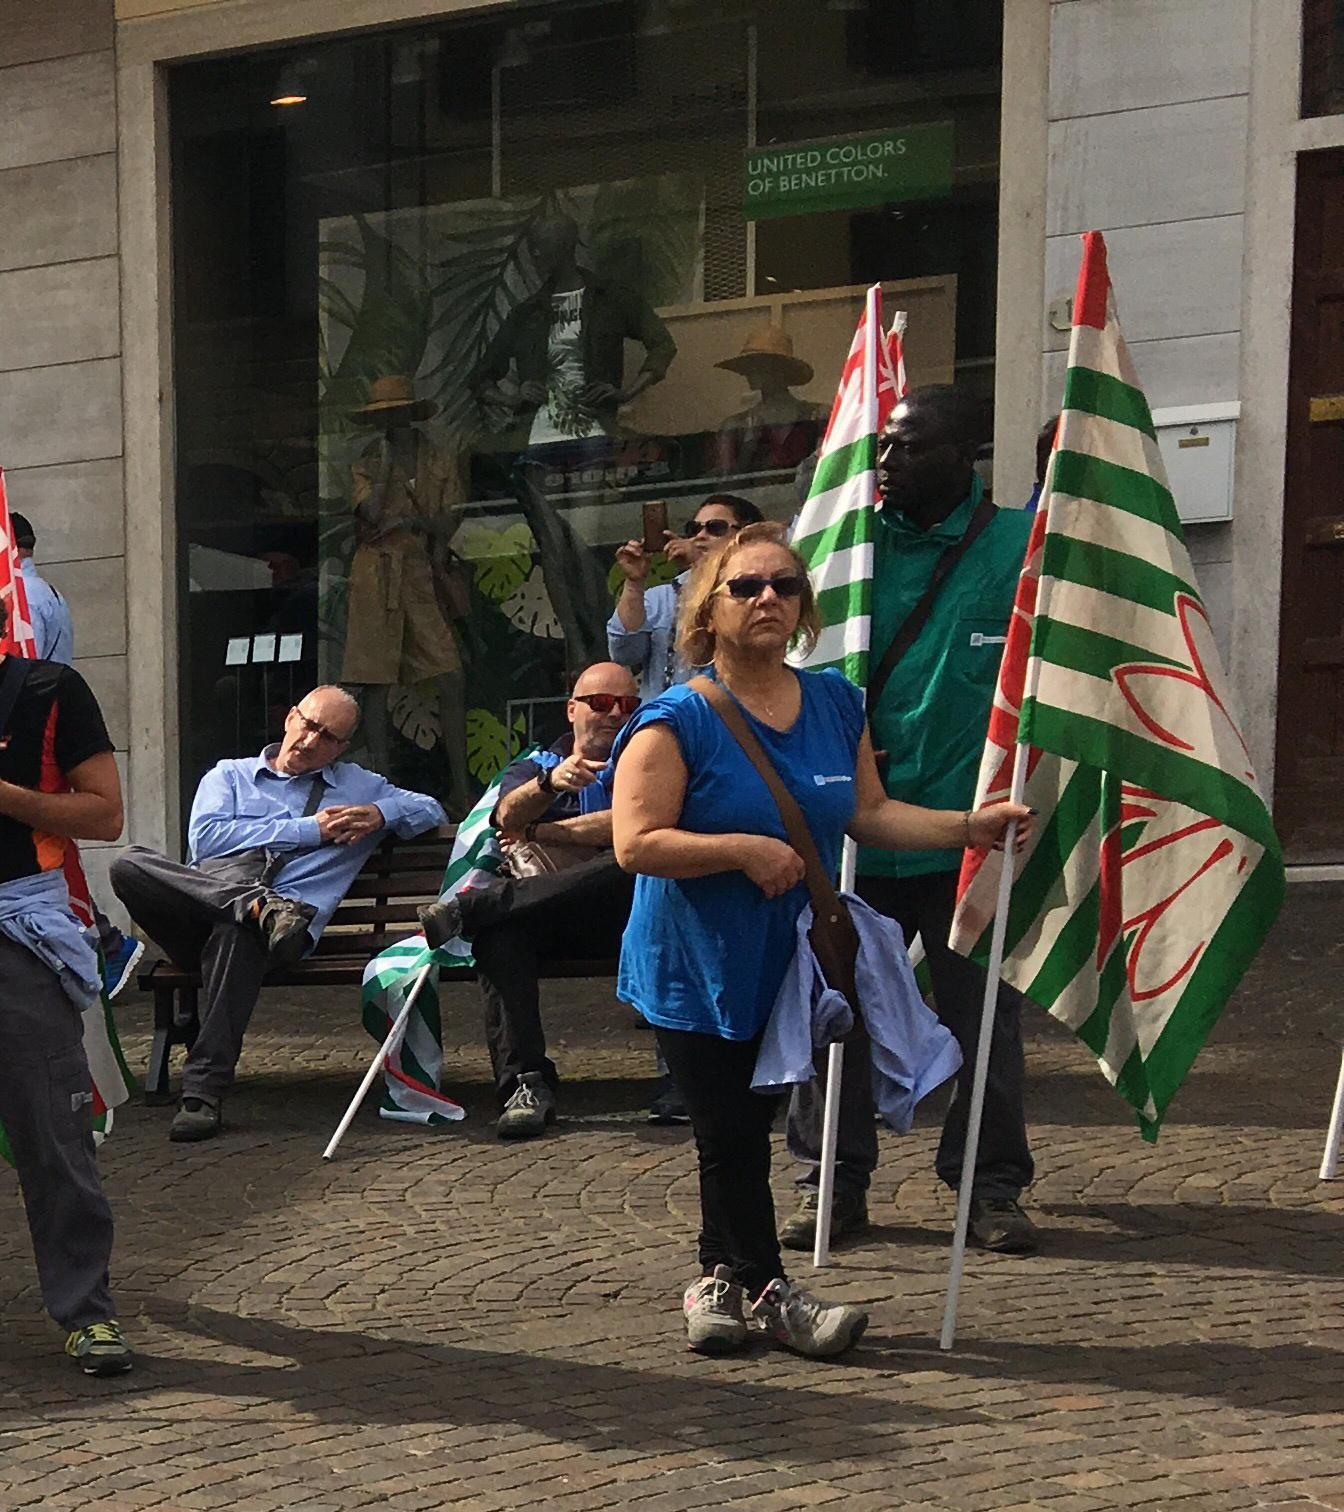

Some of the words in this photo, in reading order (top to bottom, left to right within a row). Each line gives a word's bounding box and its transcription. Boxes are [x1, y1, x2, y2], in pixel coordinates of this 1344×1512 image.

[748, 151, 821, 176] UNITED
[826, 138, 906, 164] COLORS
[748, 177, 774, 195] OF
[779, 163, 889, 192] BENETTON.
